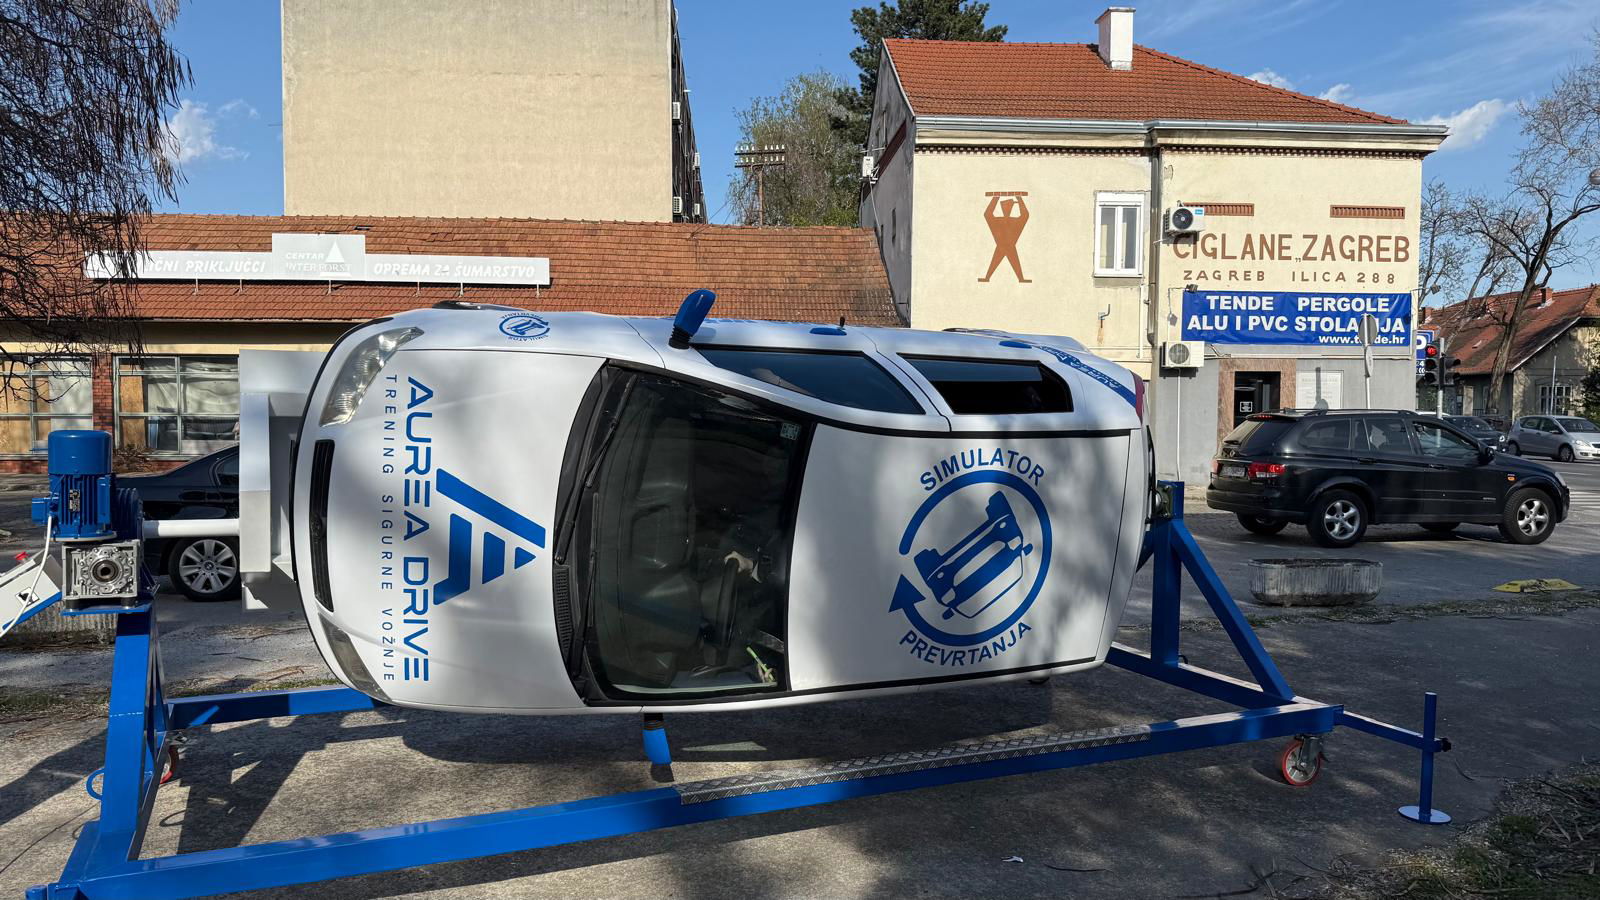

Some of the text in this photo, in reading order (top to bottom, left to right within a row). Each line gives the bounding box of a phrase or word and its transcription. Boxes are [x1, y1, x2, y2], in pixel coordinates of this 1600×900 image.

[1173, 232, 1292, 260] CIGLANE
[285, 252, 325, 260] CENTAR
[185, 258, 266, 273] PRIKLJUČCI
[373, 262, 430, 275] OPREMA
[454, 261, 535, 278] ŠUMARSTVO
[1183, 270, 1395, 284] ZAGREB ILICA 288
[1206, 295, 1390, 313] TENDE PERGOLE
[1187, 315, 1405, 333] ALU I PVC STOLAIJA
[1319, 335, 1405, 344] www.tde.hr
[919, 448, 1045, 491] SIMULATOR
[381, 374, 397, 681] TRENING SIGURNE VOŽNJE
[402, 376, 434, 682] AUREA DRIVE
[899, 621, 1032, 667] PREVRTANJA
